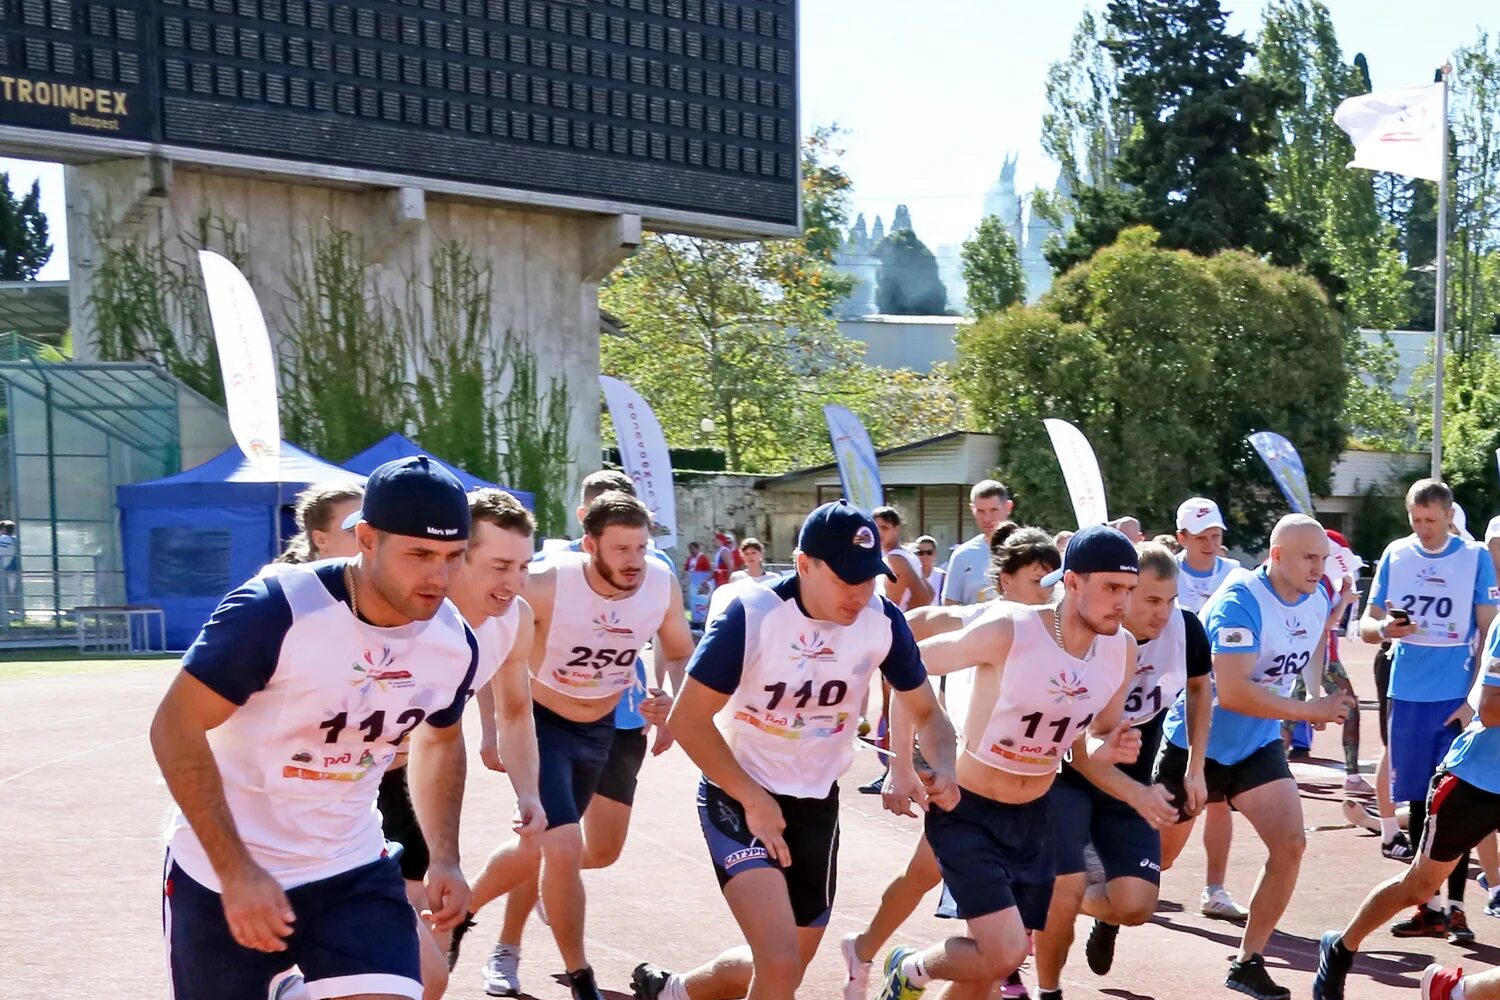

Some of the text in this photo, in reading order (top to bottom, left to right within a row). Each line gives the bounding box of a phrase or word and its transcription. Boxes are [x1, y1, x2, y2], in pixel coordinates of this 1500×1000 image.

[0, 76, 128, 115] TROIMPEX
[1402, 594, 1452, 618] 270
[566, 646, 637, 670] 250
[1264, 651, 1310, 677] 262
[764, 680, 848, 710] 110
[319, 708, 426, 747] 112
